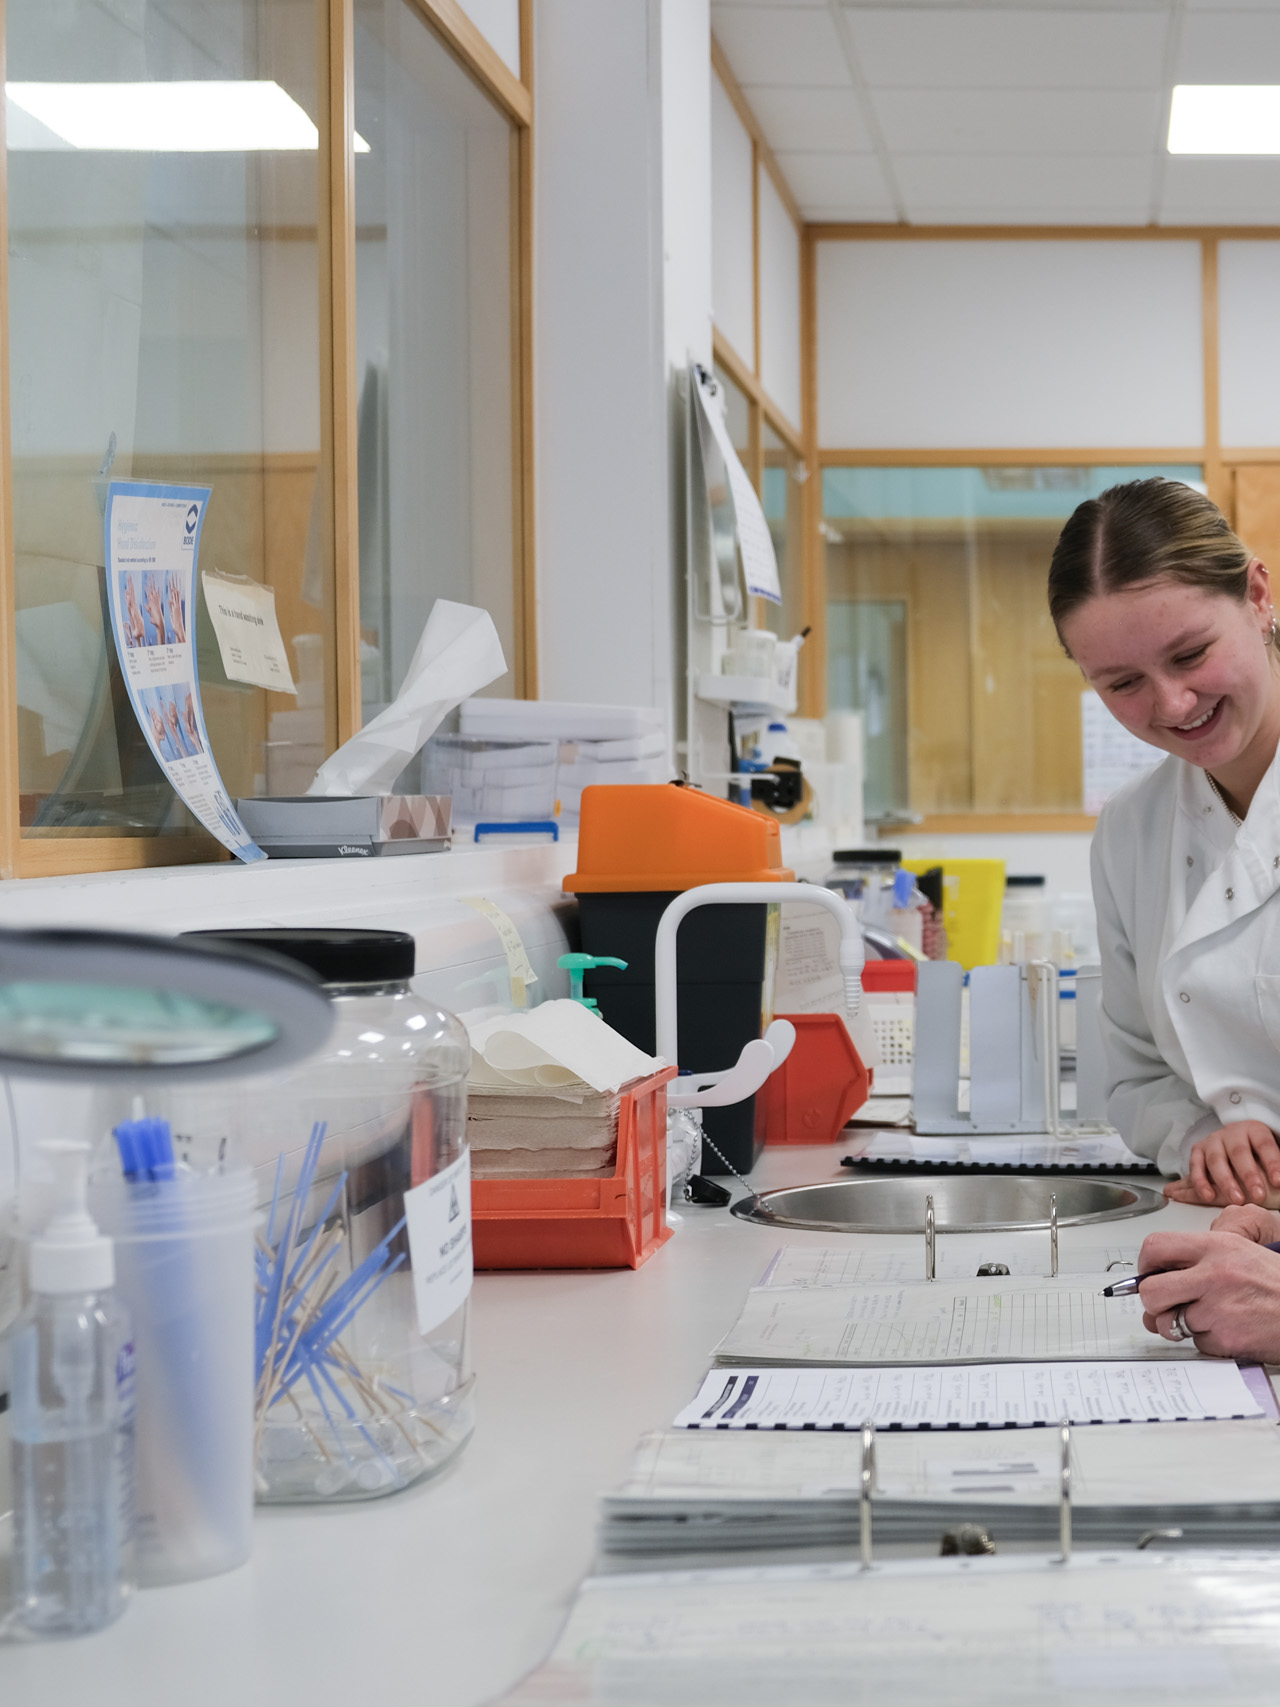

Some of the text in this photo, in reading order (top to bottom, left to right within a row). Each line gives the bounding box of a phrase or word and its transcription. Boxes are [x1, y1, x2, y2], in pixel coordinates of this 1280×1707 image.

[183, 536, 195, 546] BODE
[218, 604, 227, 616] This
[337, 845, 369, 856] Kleenex
